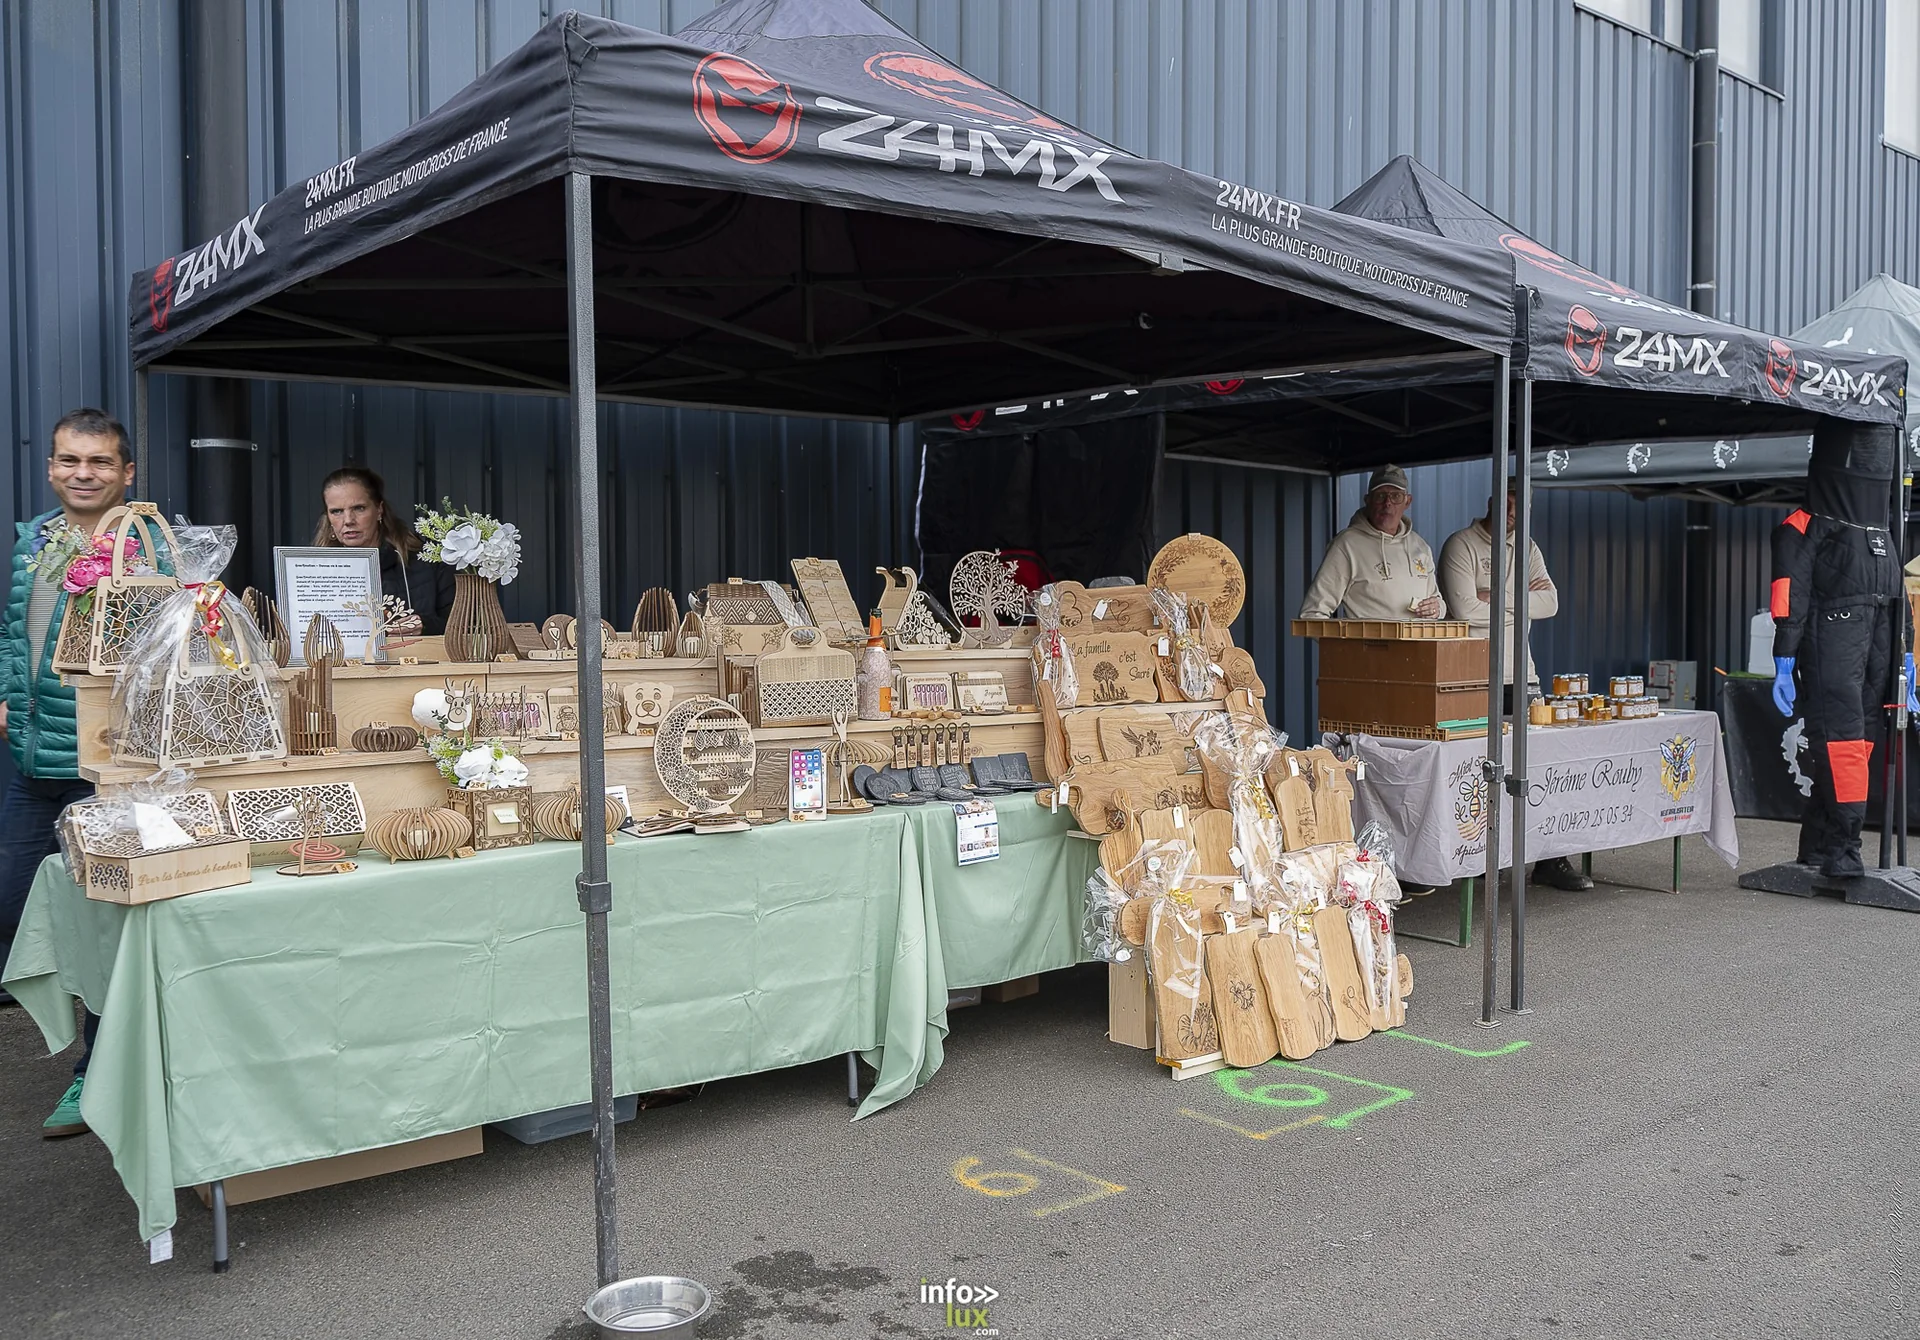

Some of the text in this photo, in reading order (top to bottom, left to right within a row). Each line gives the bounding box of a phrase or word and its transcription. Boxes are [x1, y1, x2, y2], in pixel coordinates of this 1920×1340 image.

[815, 96, 1126, 203] 24MX
[304, 117, 510, 235] LA PLUS GRANDE BOUTIQUE MOTOCROSS DE FRANCE
[305, 156, 357, 208] 24MX.FR
[1216, 181, 1301, 230] 24MX.FR
[174, 202, 267, 307] 24MX
[1212, 213, 1470, 309] LA PLUS GRANDE BOUTIQUE MOTOCROSS DE FRANCE
[1613, 326, 1730, 378] 24MX
[1799, 360, 1888, 407] 24MX
[1083, 640, 1111, 658] famille
[1119, 651, 1137, 663] c'est
[1129, 667, 1150, 681] Sacré
[373, 721, 387, 729] 15€
[1528, 757, 1643, 807] Jérôme Rouby
[1537, 816, 1555, 836] +32
[1591, 808, 1604, 828] 25
[1606, 805, 1619, 825] 05
[1621, 804, 1634, 822] 34
[138, 861, 242, 887] Pour les larmes de bonheur
[951, 1157, 1040, 1197] 6
